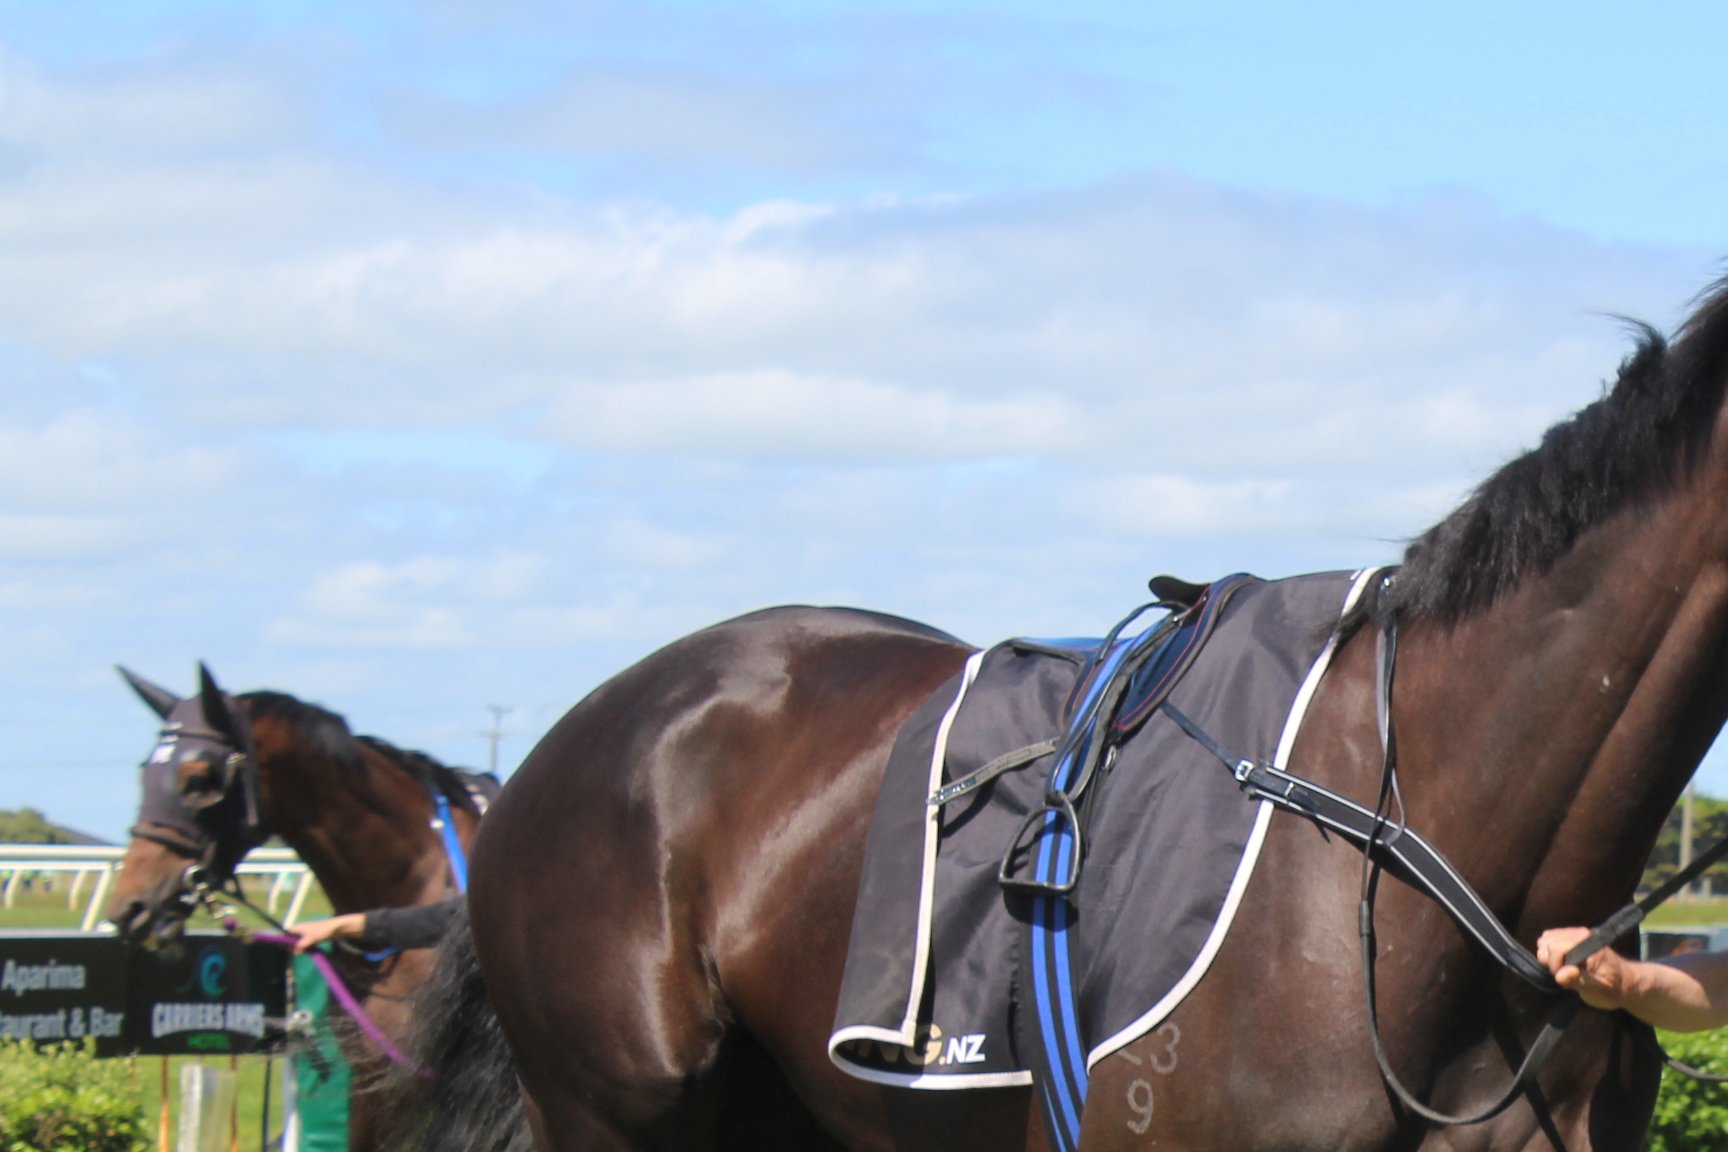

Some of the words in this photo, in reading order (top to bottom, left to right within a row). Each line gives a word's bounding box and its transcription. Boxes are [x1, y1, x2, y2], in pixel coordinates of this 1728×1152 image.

[1, 958, 86, 996] Aparima
[0, 1008, 66, 1039] aurant
[69, 1007, 86, 1037] &
[89, 1006, 124, 1037] Bar
[152, 1002, 224, 1038] CARRIERS
[225, 1003, 265, 1039] ARMS
